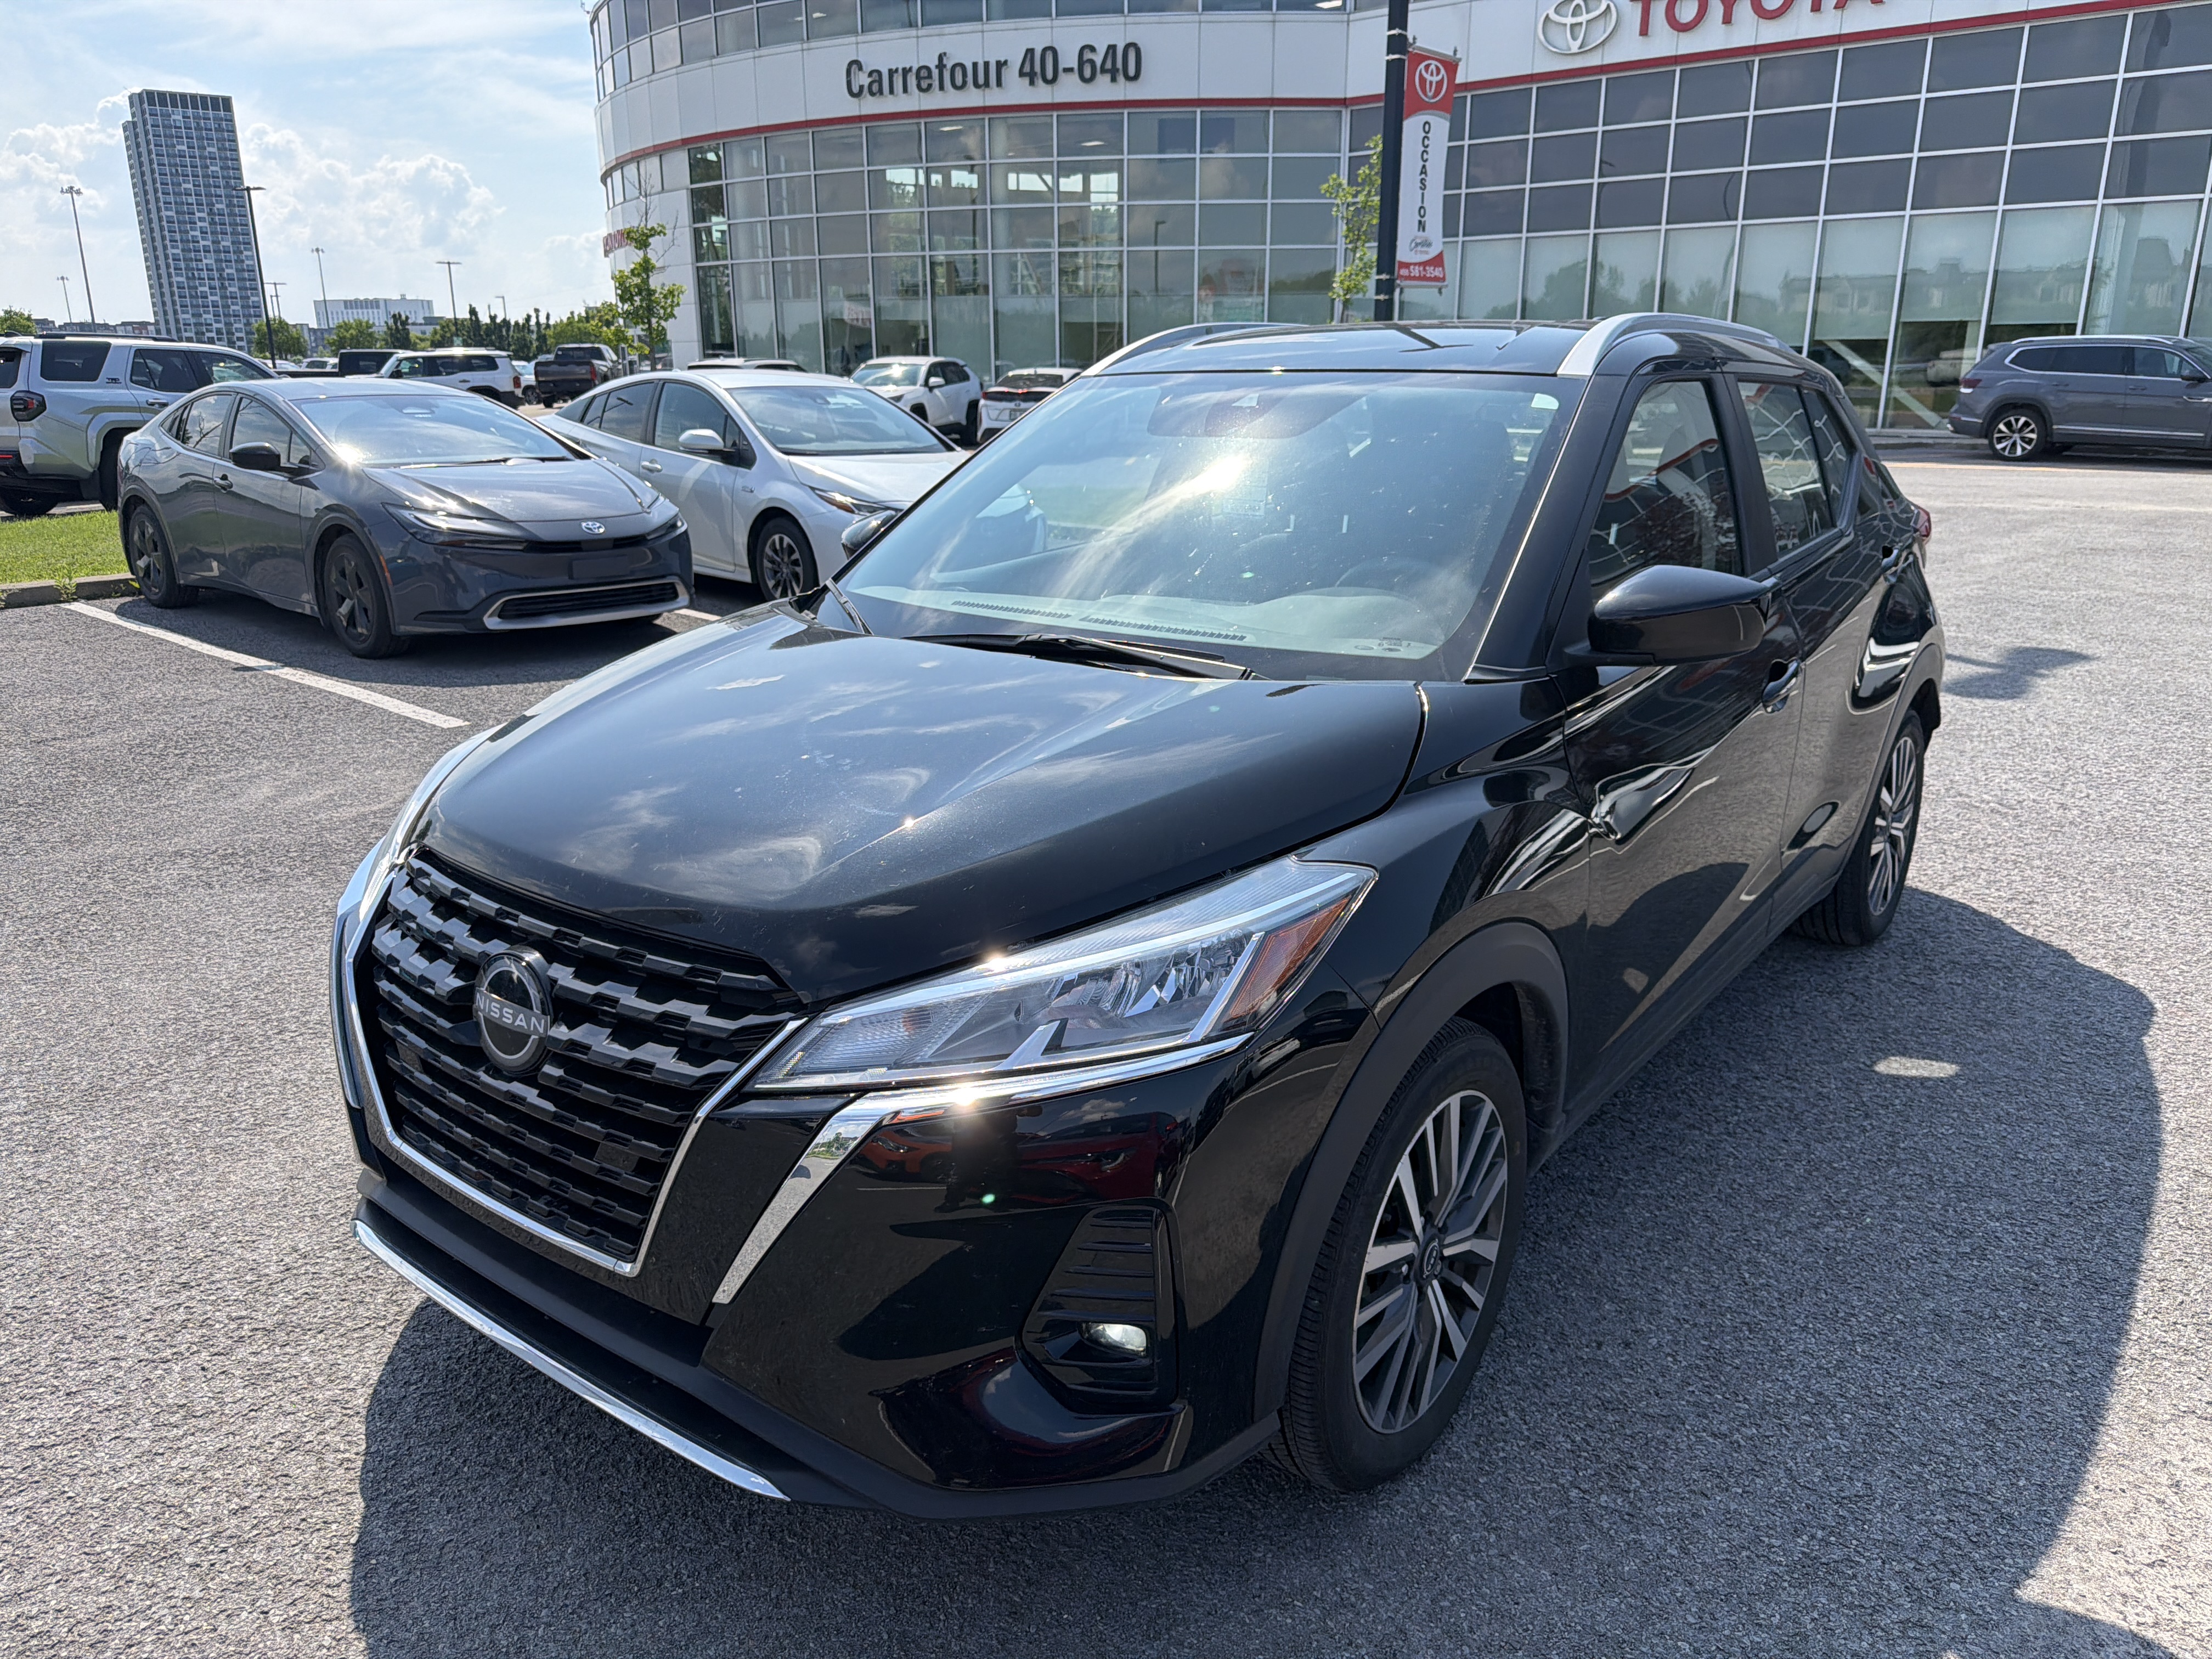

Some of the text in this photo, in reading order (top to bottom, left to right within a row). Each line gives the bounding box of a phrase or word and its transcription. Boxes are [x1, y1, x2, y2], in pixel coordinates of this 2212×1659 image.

[1629, 0, 1884, 36] TOY
[845, 41, 1142, 98] Carrefour 40-640
[1417, 121, 1431, 233] OCCASION
[476, 992, 544, 1034] NISSAN
